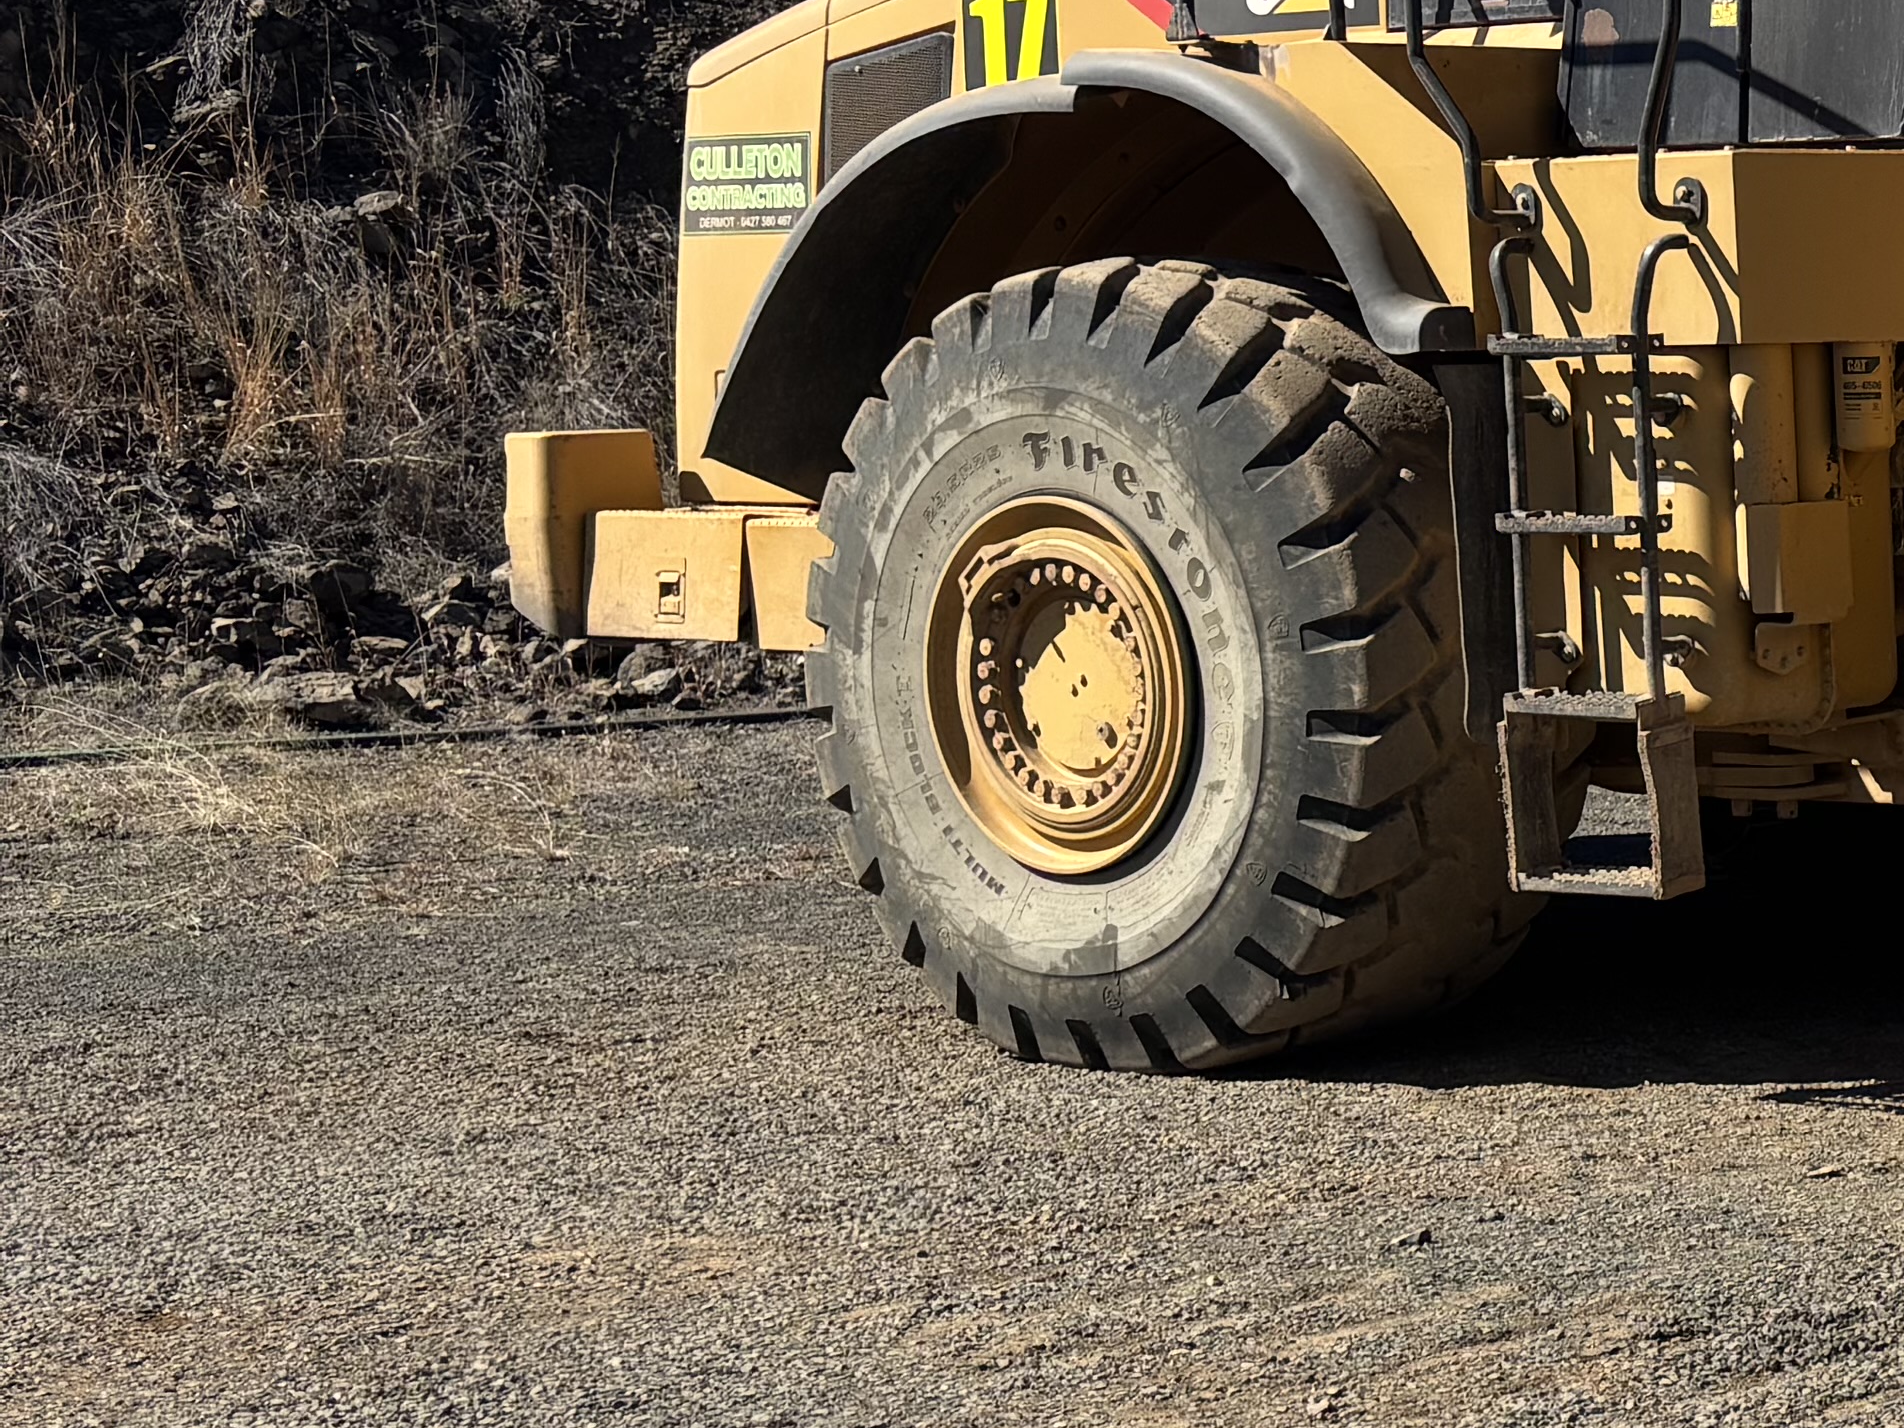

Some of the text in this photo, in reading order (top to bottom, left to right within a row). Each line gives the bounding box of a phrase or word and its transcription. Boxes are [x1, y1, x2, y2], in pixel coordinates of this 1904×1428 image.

[690, 143, 802, 181] CULLETON
[686, 182, 806, 211] CONTRACTING
[699, 216, 735, 228] DERMOT
[1847, 359, 1868, 372] CAT
[1022, 430, 1235, 702] Firestone
[900, 705, 942, 816] BLOCK
[943, 824, 1005, 896] MULTI
